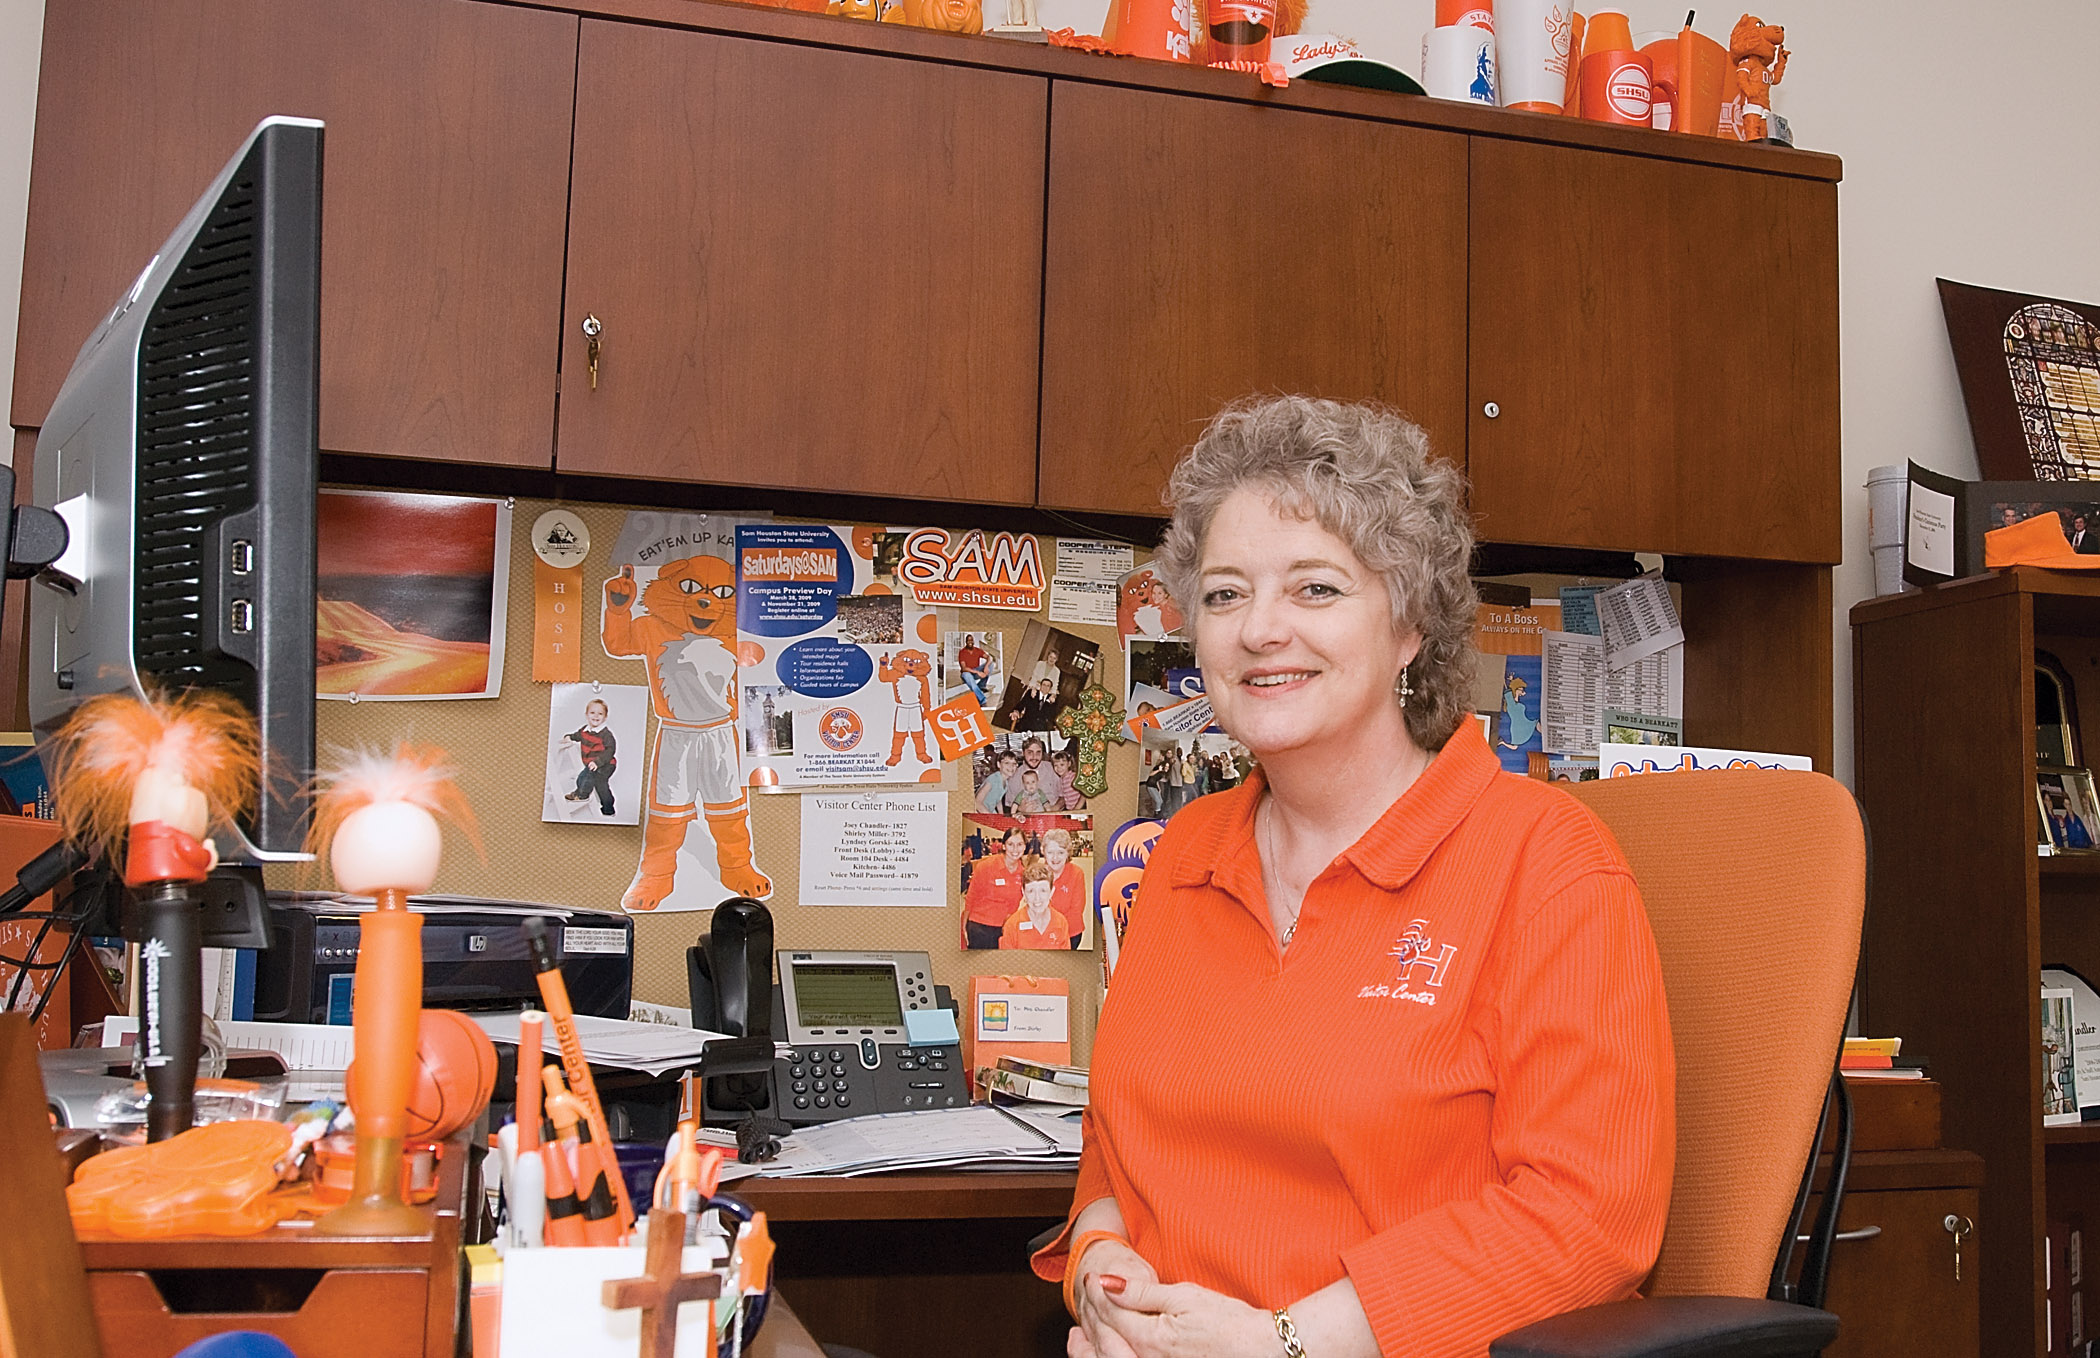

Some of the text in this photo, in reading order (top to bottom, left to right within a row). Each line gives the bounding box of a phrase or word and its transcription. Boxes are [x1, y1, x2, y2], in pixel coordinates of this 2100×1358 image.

[1617, 87, 1649, 99] SHSU
[692, 532, 711, 543] UP
[717, 534, 734, 547] KA
[744, 550, 836, 580] Saturdays@SAM
[903, 533, 1040, 587] SAM
[749, 587, 781, 595] Campus
[918, 590, 1035, 606] www.shsu.edu
[553, 582, 567, 655] HOST
[1490, 613, 1538, 624] To A Boss
[937, 709, 987, 751] SH
[816, 800, 936, 812] Visitor Center Phone List
[870, 847, 895, 855] (Lobby)
[1391, 983, 1436, 1006] Center
